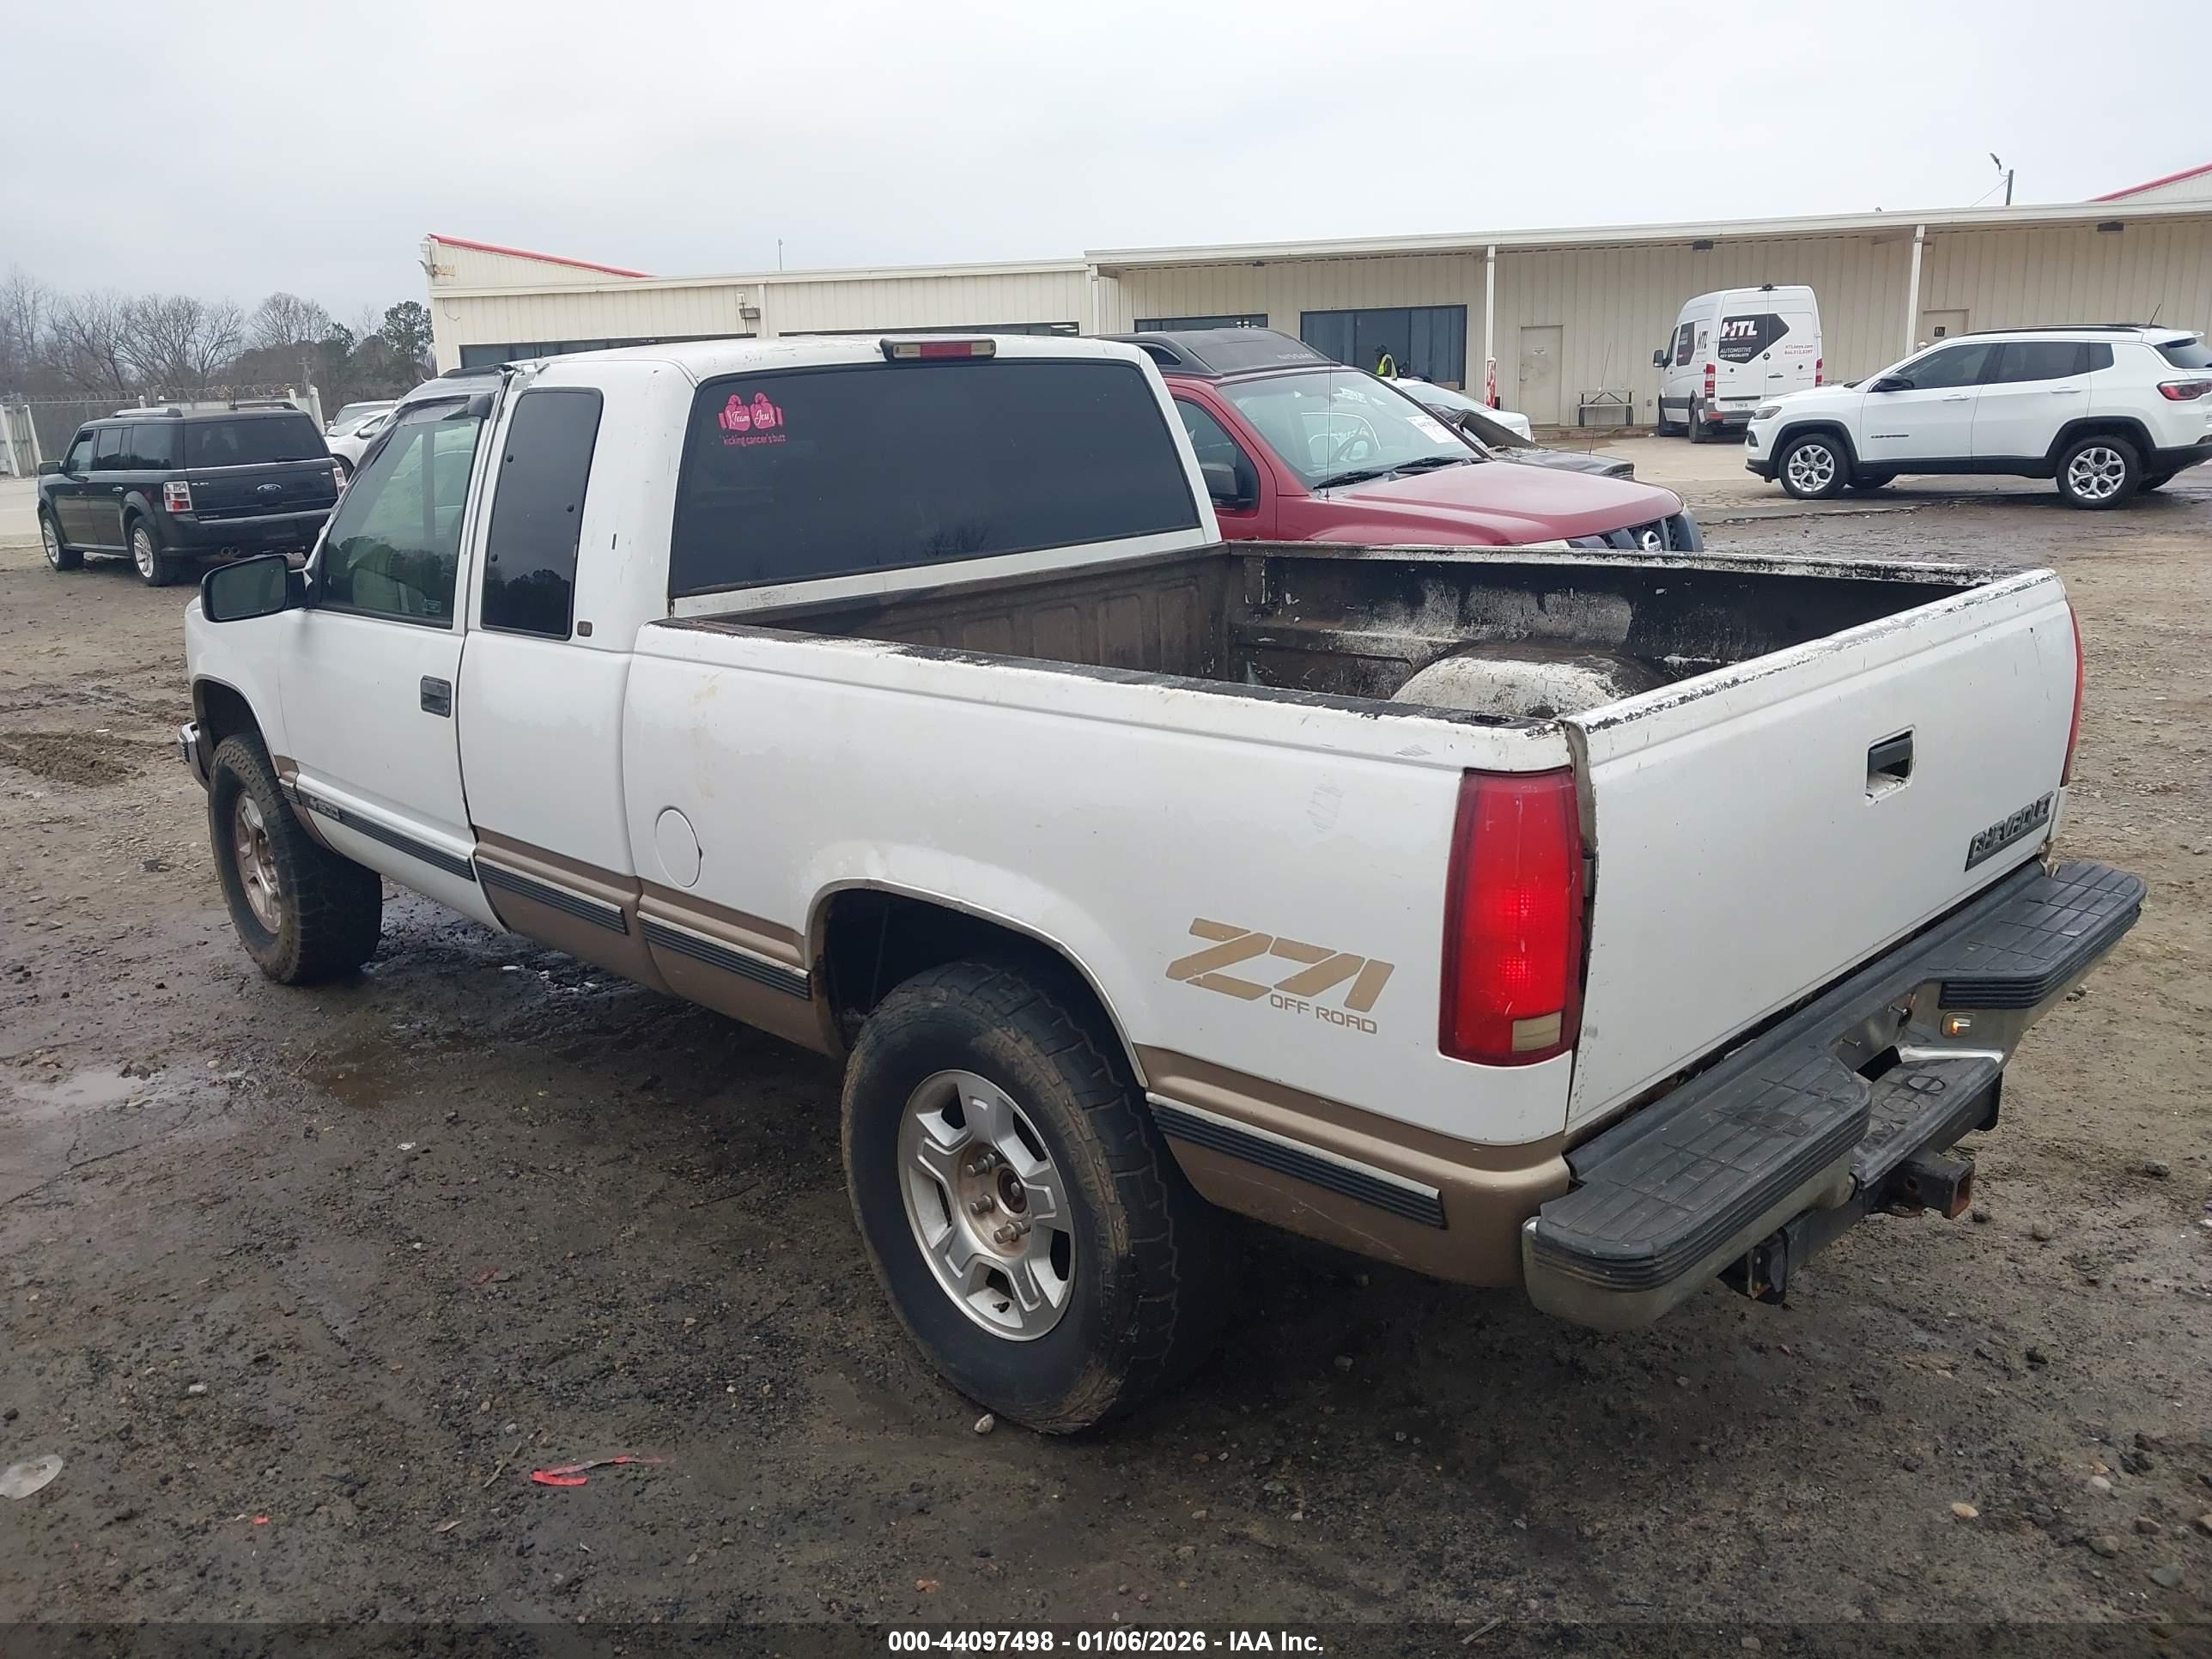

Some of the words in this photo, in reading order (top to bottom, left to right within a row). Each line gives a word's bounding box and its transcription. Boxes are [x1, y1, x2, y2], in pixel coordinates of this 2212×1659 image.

[1721, 320, 1758, 337] HTL
[1966, 790, 2054, 862] CHEVROLET
[1165, 918, 1395, 1013] Z71
[1270, 994, 1310, 1014] OFF
[1316, 1006, 1377, 1034] ROAD
